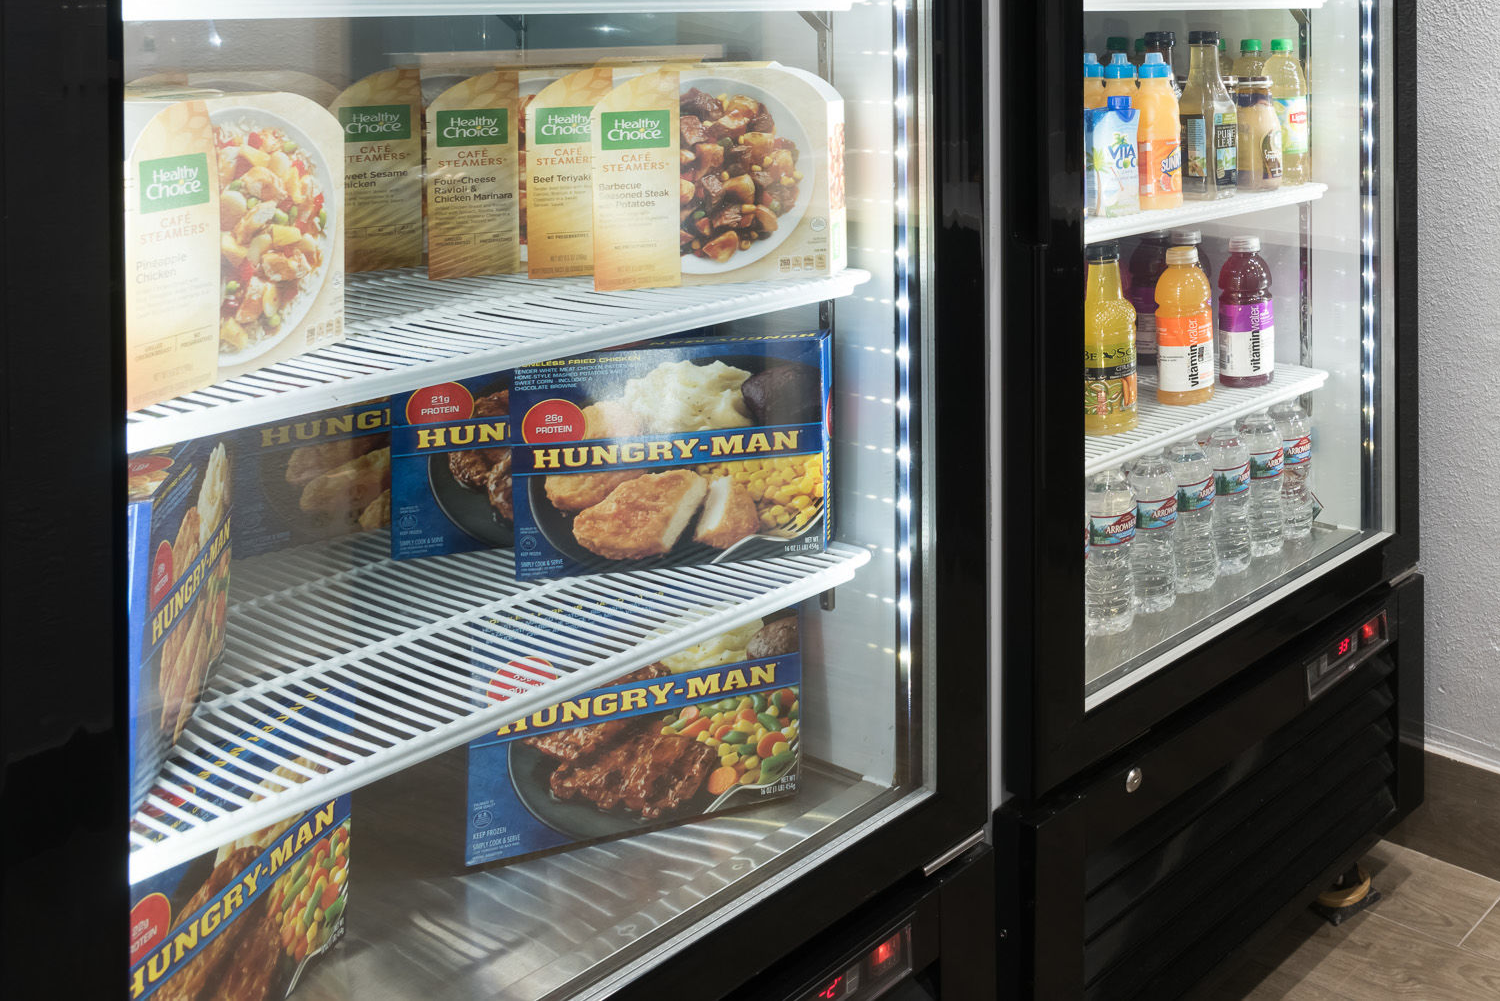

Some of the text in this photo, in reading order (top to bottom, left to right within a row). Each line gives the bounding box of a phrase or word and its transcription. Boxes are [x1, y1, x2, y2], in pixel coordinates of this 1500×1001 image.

[352, 112, 400, 124] Healthy
[450, 116, 498, 128] Healthy
[614, 118, 660, 129] Healthy
[345, 122, 402, 134] Choice
[443, 127, 499, 139] Choice
[607, 129, 662, 141] Choice
[360, 143, 391, 154] CAFÉ
[457, 148, 489, 159] CAFÉ
[554, 146, 582, 157] CAFÉ
[1108, 143, 1136, 160] VITA
[438, 157, 503, 168] STEAMERS
[621, 152, 652, 162] CAFÉ
[602, 162, 666, 173] STEAMERS
[152, 165, 199, 183] Healthy
[370, 170, 408, 178] Sesame
[533, 175, 554, 184] Beef
[434, 176, 496, 186] Four-Cheese
[599, 182, 642, 190] Barbecue
[146, 179, 202, 201] Choice
[434, 186, 468, 195] Ravioli
[644, 189, 669, 198] Steak
[434, 192, 513, 204] Chicken Marinara
[160, 210, 192, 229] CAFÉ
[139, 222, 206, 246] STEAMERS
[136, 252, 187, 272] Pineapple
[135, 268, 177, 285] Chicken
[431, 395, 450, 405] 21g
[420, 403, 460, 417] PROTEIN
[545, 414, 563, 423] 26g
[535, 425, 573, 434] PROTEIN
[533, 429, 799, 470] HUNGRY-MAN
[152, 515, 232, 646] HUNGRY-MAN
[472, 827, 507, 840] KEEP FROZEN
[472, 842, 488, 850] SIMPLY
[490, 838, 502, 847] COOK
[507, 833, 520, 843] SERVE
